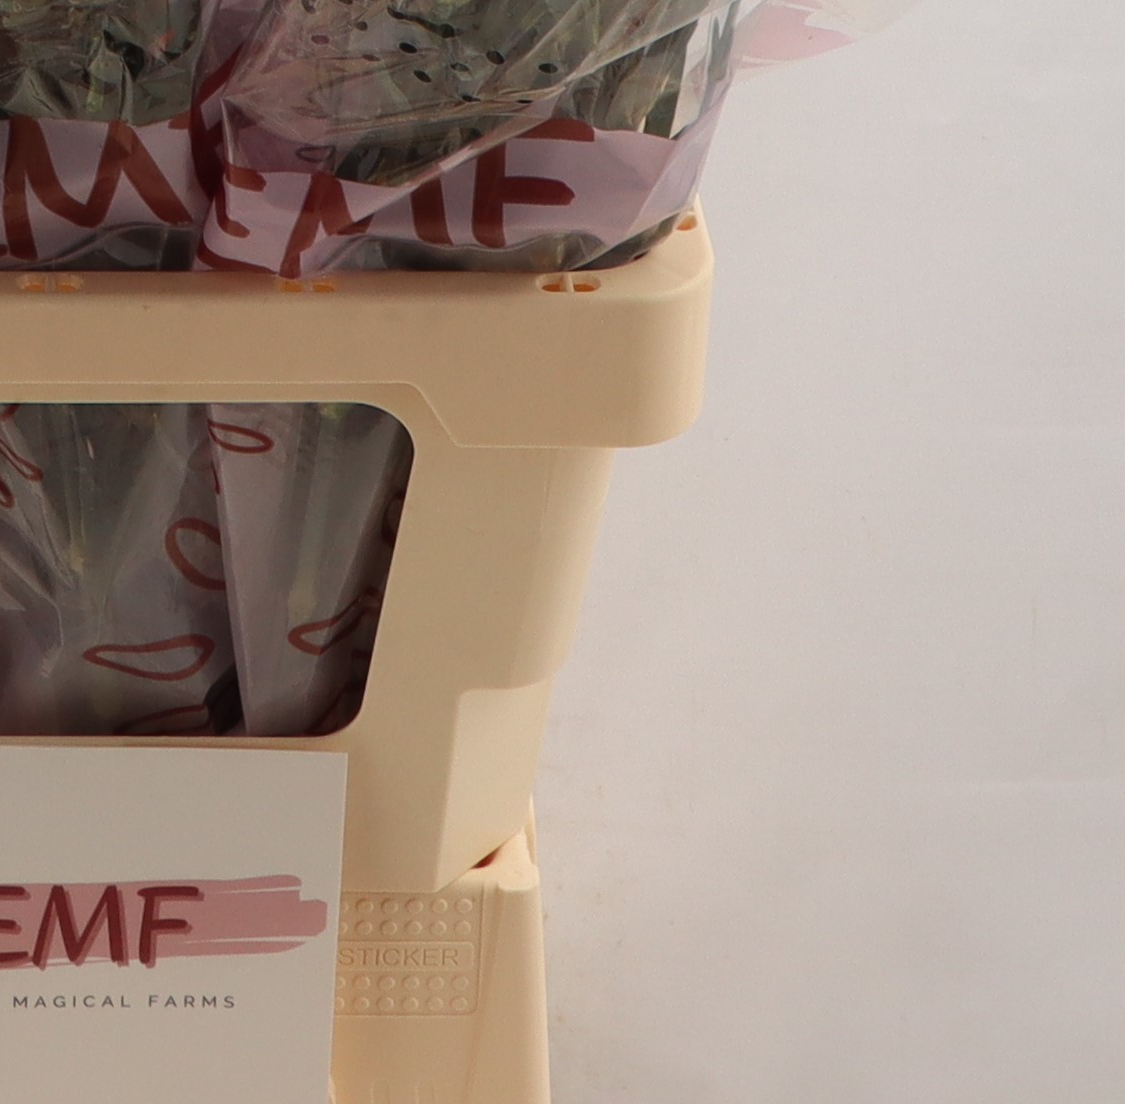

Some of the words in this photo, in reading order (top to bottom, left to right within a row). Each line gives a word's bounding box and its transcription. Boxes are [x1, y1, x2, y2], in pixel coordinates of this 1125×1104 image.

[338, 947, 459, 967] STICKER
[12, 994, 131, 1009] MAGICAL
[147, 994, 236, 1009] FARMS
